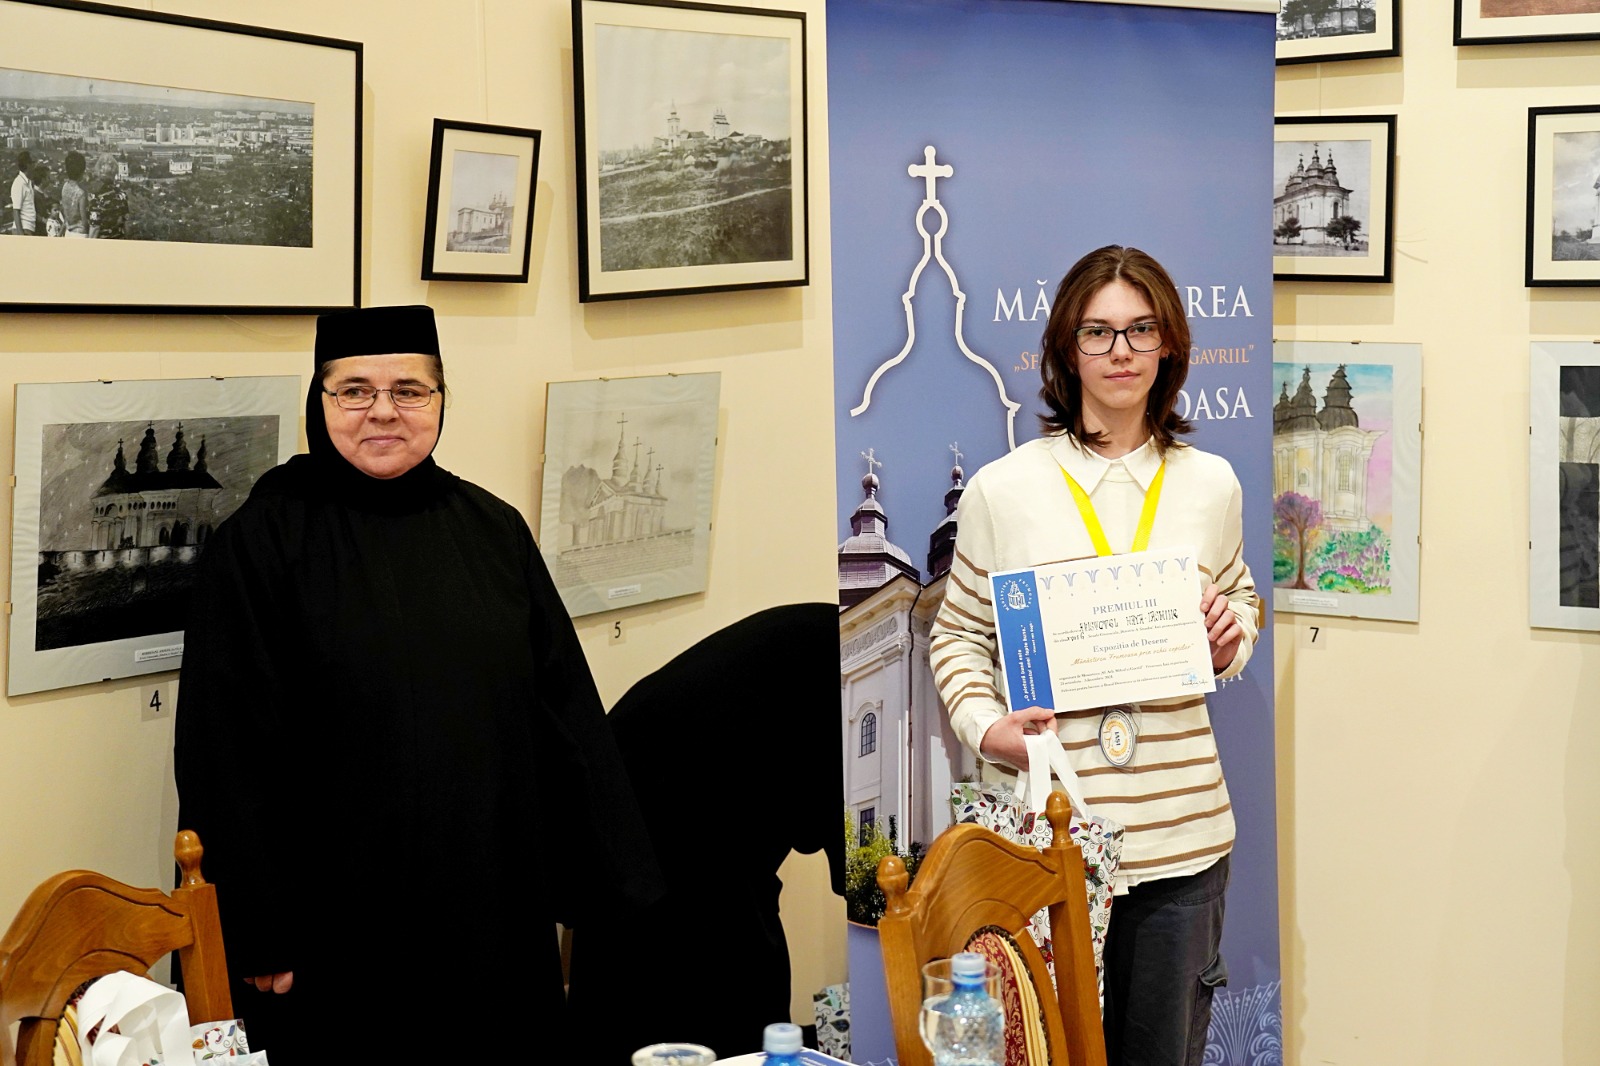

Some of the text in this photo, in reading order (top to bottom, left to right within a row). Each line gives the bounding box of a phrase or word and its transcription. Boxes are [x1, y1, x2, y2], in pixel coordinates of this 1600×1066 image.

[1093, 599, 1157, 615] PREMIUL III
[614, 621, 621, 639] 5
[1310, 627, 1319, 643] 7
[1093, 642, 1129, 654] Expoziția
[1141, 636, 1168, 646] Desene
[149, 690, 162, 712] 4
